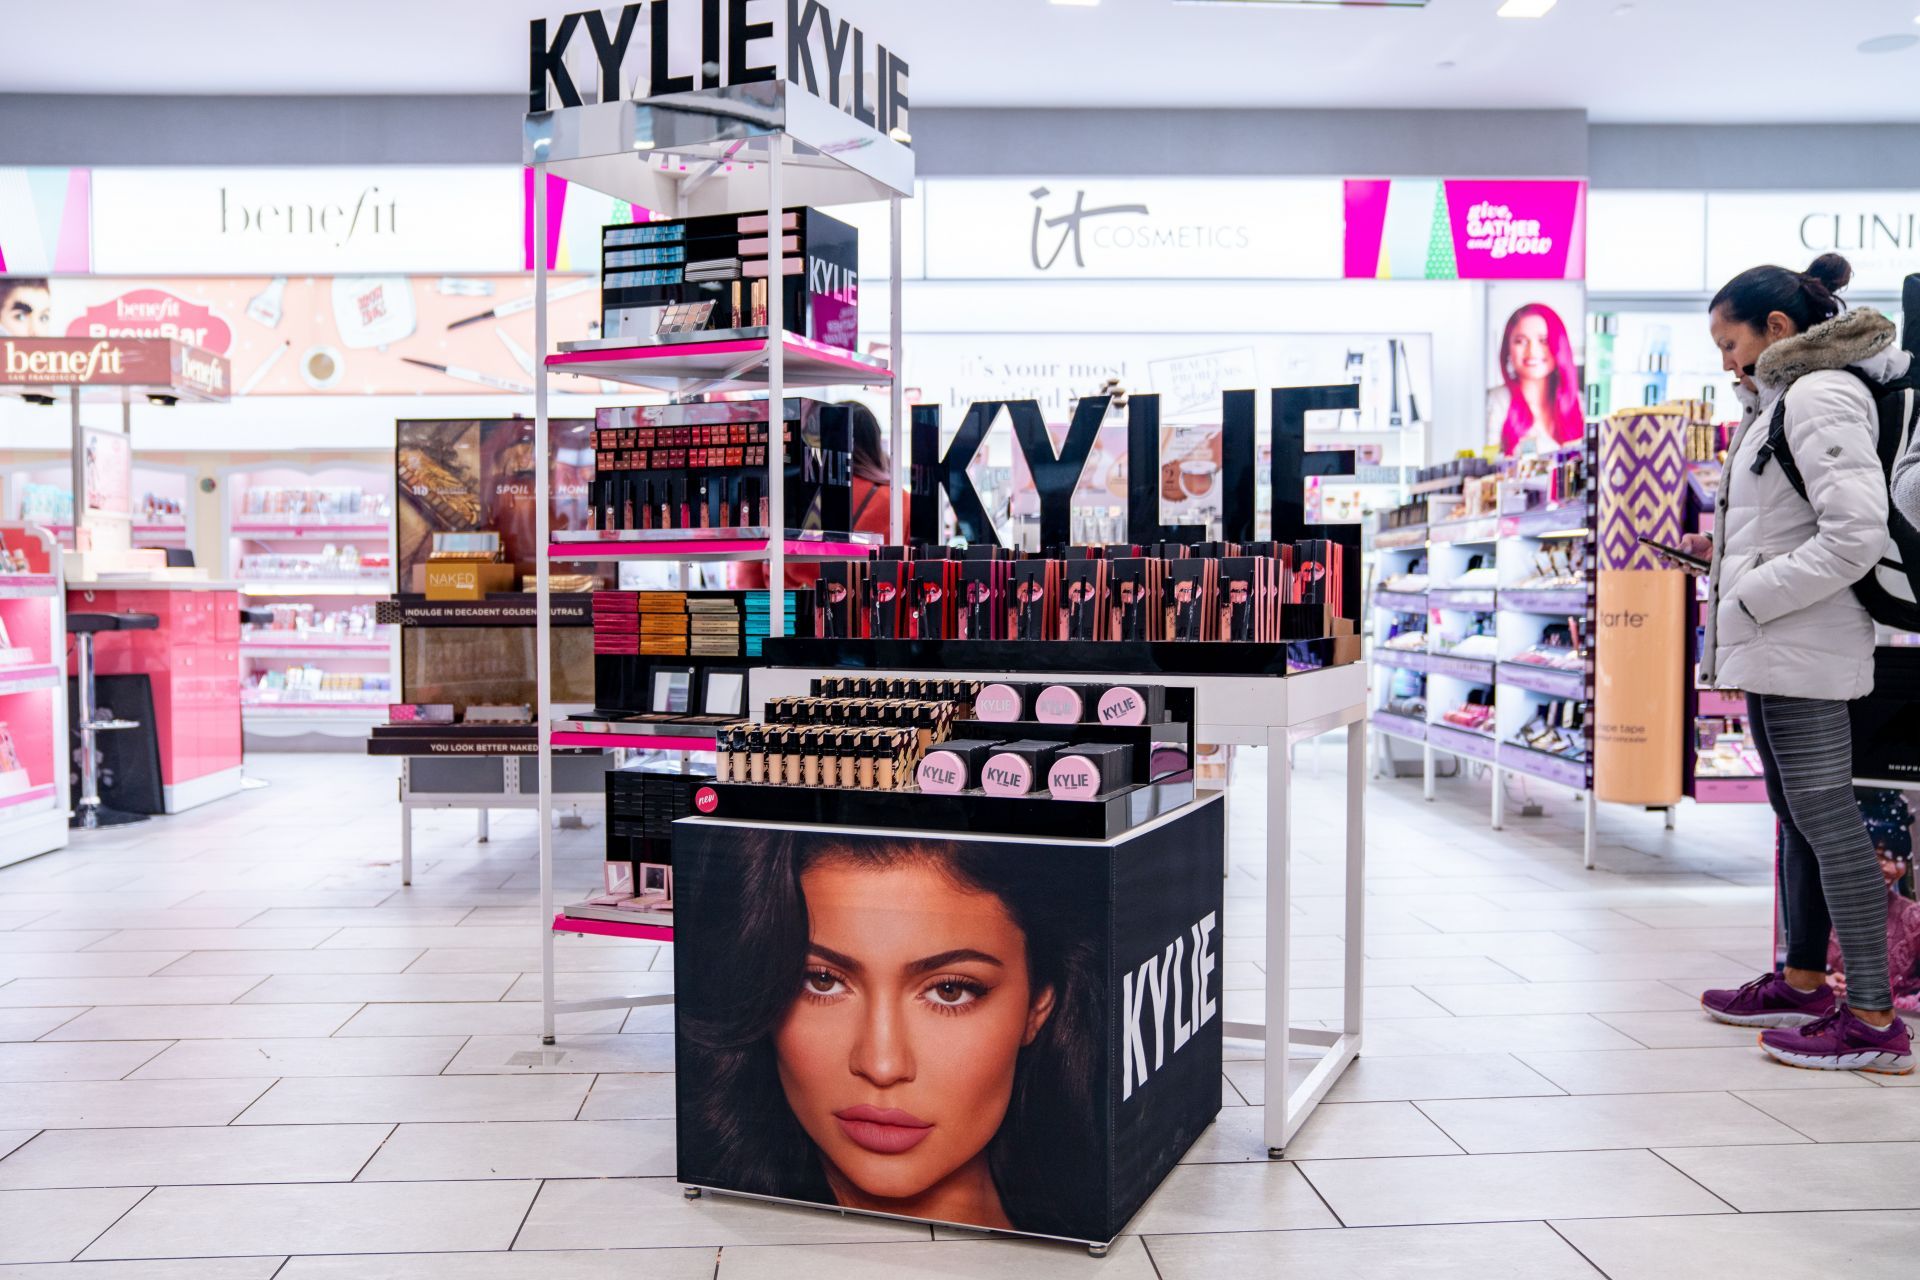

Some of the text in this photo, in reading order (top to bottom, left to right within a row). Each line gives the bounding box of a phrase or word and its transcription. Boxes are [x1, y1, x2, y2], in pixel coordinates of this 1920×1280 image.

[530, 0, 777, 113] KYLIE
[787, 0, 909, 149] KYLIE
[219, 186, 397, 247] benefit
[1467, 219, 1540, 238] GATHER
[1094, 225, 1249, 250] COSMETICS
[1800, 212, 1920, 250] CLINI
[1490, 236, 1552, 259] glow
[810, 255, 857, 306] KYLIE
[117, 298, 180, 321] benefit
[4, 341, 124, 382] benefit
[182, 347, 224, 392] benefit
[1003, 363, 1060, 385] your
[1069, 360, 1127, 378] most
[804, 446, 852, 487] KYLIE
[911, 384, 1363, 548] KYLIE
[496, 484, 529, 495] SPOIL
[430, 573, 475, 586] NAKED
[405, 608, 584, 617] INDULGE IN DECADENT GOLDEN UTRALS
[981, 699, 1013, 713] KYLIE
[1103, 697, 1136, 721] KYLIE
[430, 744, 538, 752] YOU LOOK BETTER NAKED
[923, 765, 956, 784] KYLIE
[987, 767, 1022, 787] KYLIE
[1054, 774, 1089, 787] KYLIE
[698, 793, 716, 806] new
[1123, 910, 1216, 1102] KYLIE
